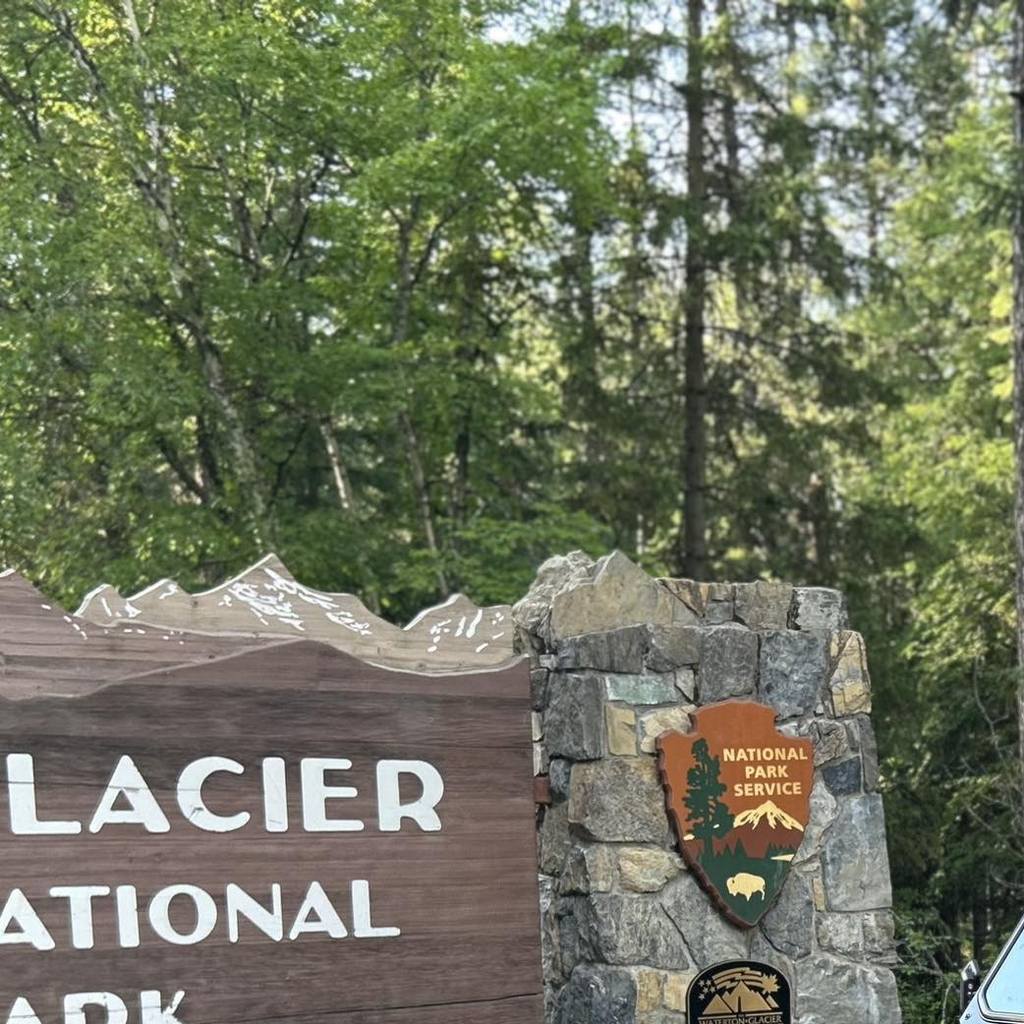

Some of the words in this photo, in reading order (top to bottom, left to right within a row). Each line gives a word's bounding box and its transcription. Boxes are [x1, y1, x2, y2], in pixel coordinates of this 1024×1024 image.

[723, 748, 808, 762] NATIONAL
[745, 765, 788, 779] PARK
[6, 753, 445, 834] LACIER
[734, 782, 802, 797] SERVICE
[0, 880, 401, 951] ATIONAL
